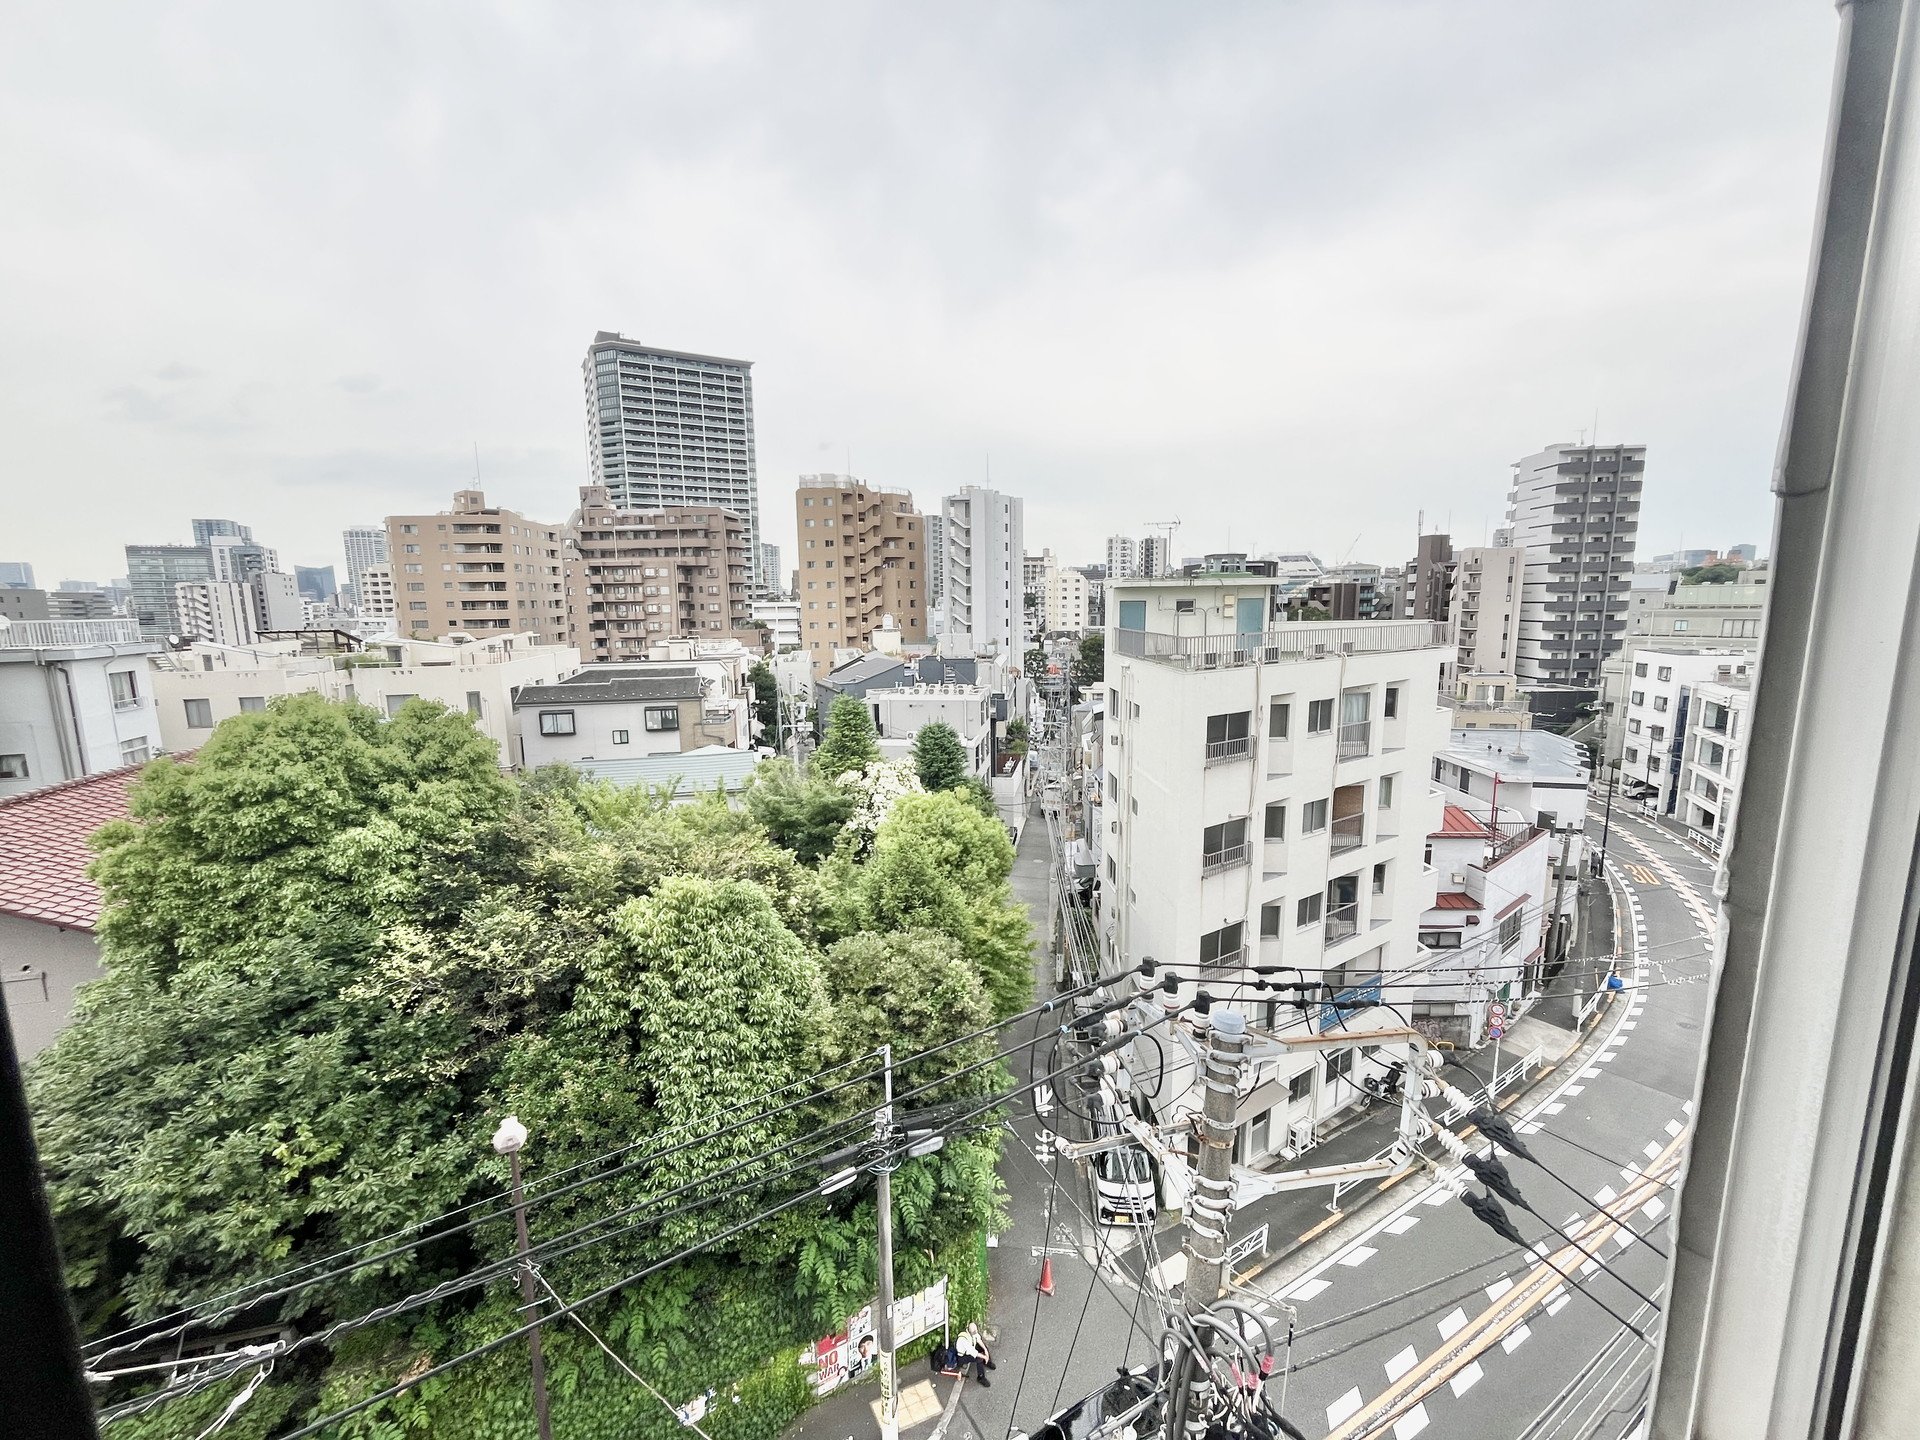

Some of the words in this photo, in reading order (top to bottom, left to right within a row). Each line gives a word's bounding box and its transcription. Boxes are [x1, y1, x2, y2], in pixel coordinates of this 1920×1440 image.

[1622, 864, 1661, 885] 30
[818, 1349, 838, 1370] NO
[818, 1362, 841, 1380] WAR
